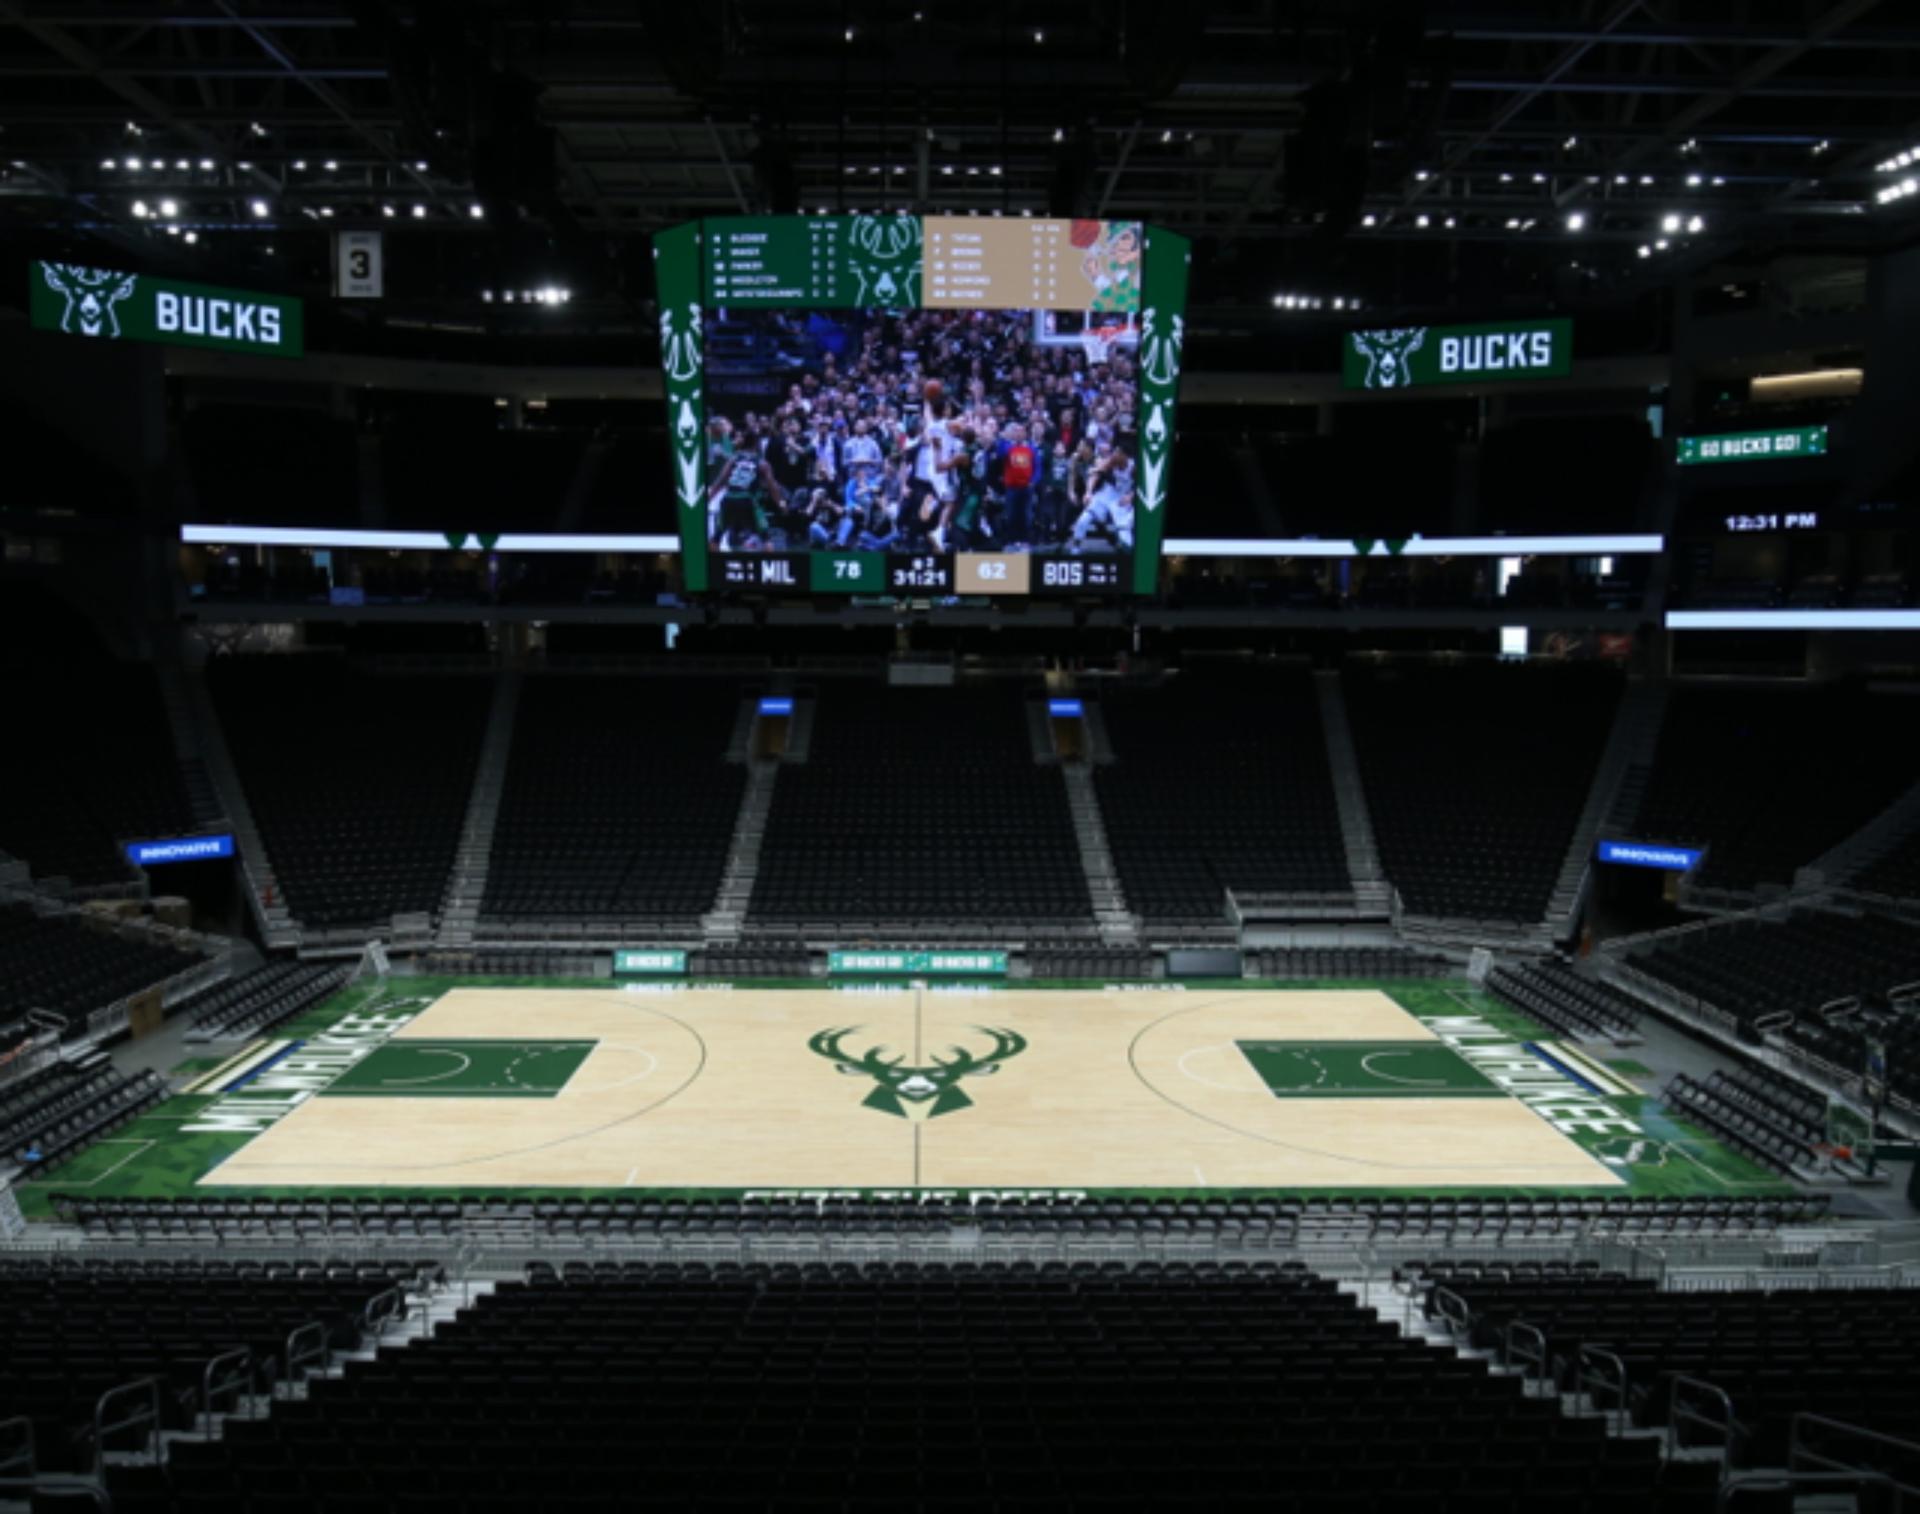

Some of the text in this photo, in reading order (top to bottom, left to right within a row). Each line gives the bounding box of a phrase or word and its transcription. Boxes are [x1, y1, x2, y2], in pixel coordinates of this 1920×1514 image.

[350, 249, 370, 279] 3
[157, 292, 281, 344] BUCKS
[1441, 332, 1550, 371] BUCKS
[1700, 433, 1801, 457] GO BUCKS GO!
[1725, 512, 1817, 531] 12:31 PM
[761, 560, 796, 584] MIL
[835, 561, 860, 579] 78
[894, 567, 947, 586] 31:21
[979, 563, 1006, 580] 62
[1042, 561, 1084, 586] BOS
[178, 1013, 414, 1132] MILWAUKEE
[1417, 1016, 1645, 1134] MILWAUKEE
